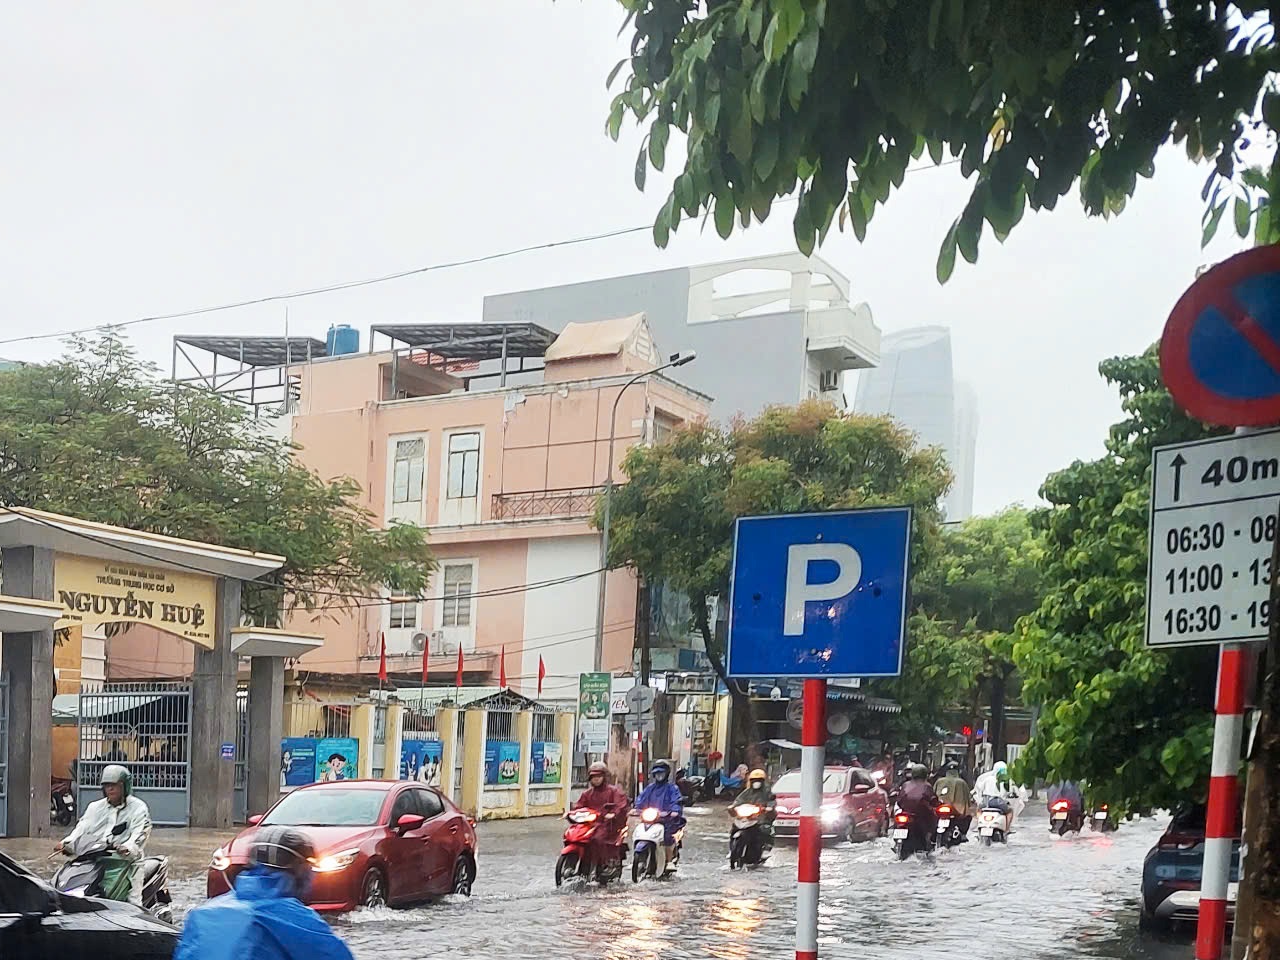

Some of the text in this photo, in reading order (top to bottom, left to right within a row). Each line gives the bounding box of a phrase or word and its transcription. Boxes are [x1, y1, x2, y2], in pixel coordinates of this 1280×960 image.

[1201, 456, 1279, 487] 40m
[1167, 522, 1225, 555] 06:30
[1251, 515, 1277, 544] 08
[783, 543, 862, 636] P
[1165, 563, 1223, 594] 11:00
[1249, 558, 1273, 587] 13
[58, 590, 205, 629] NGUYỄN HUỆ
[1164, 604, 1221, 635] 16:30
[1247, 600, 1270, 629] 19
